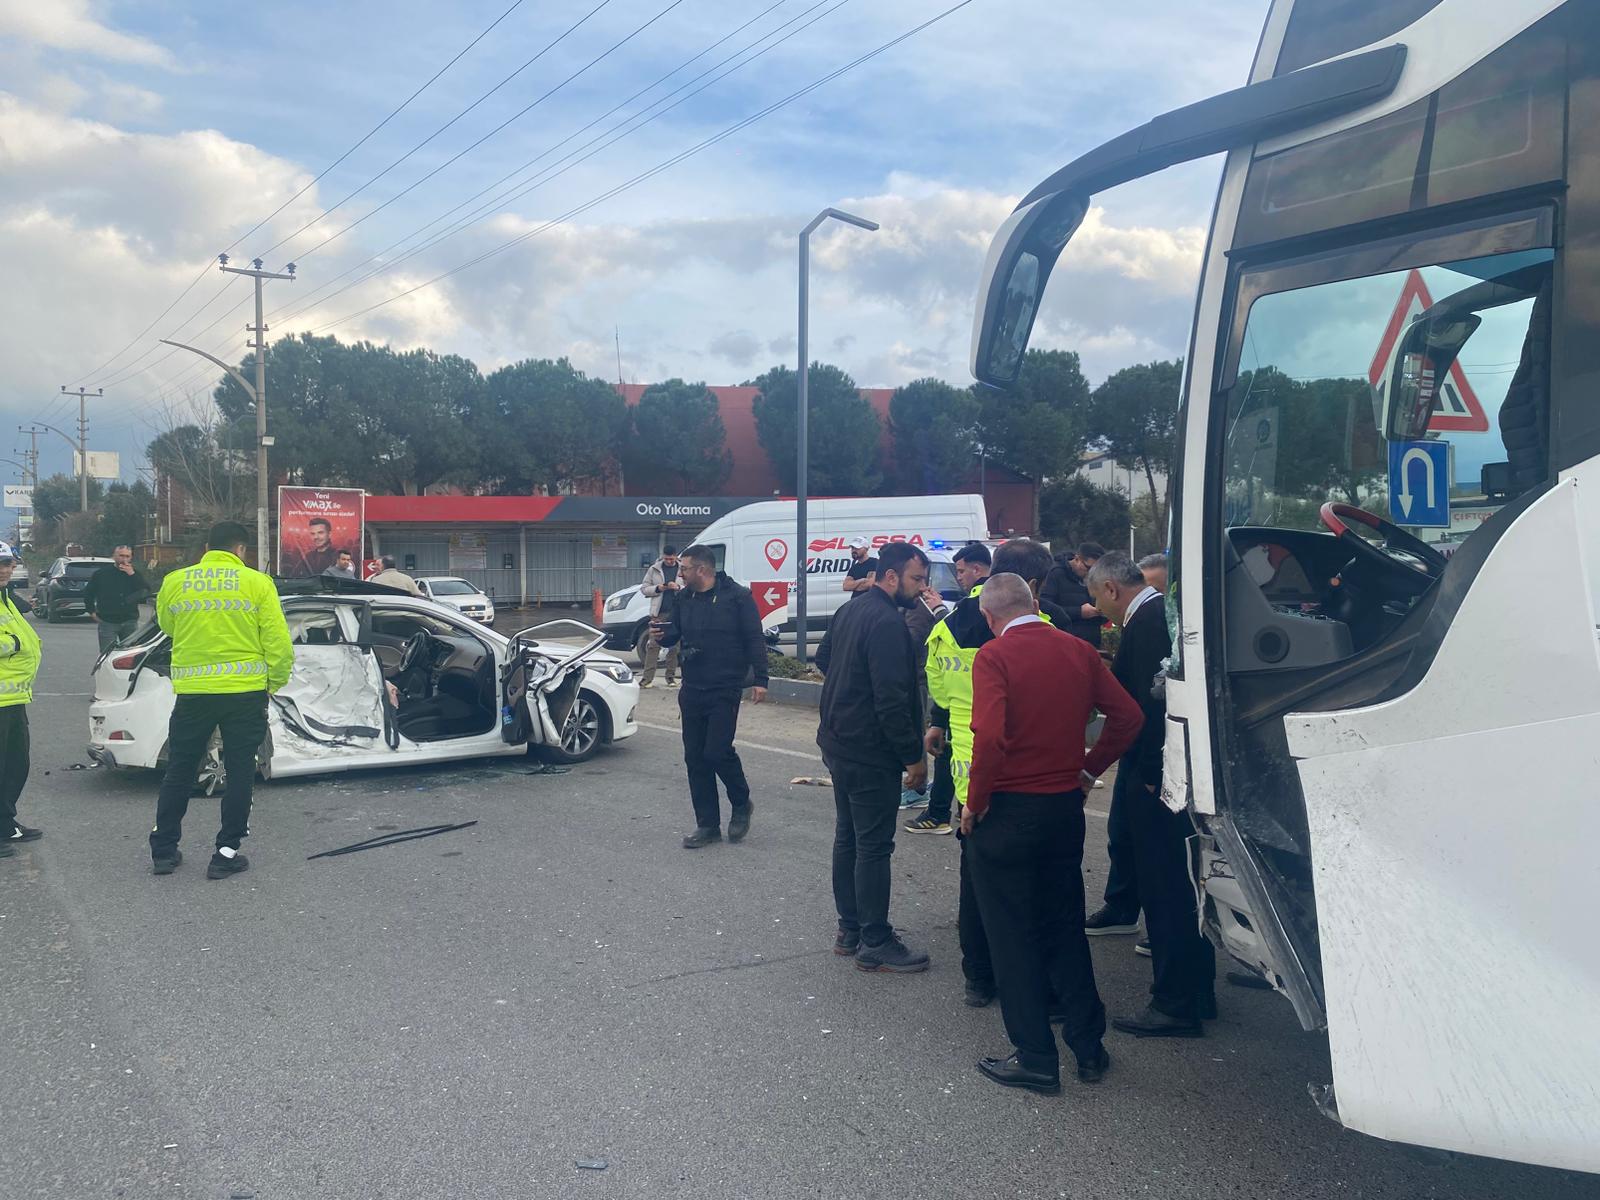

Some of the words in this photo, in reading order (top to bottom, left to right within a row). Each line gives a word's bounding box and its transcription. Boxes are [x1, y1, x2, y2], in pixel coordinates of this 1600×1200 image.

[314, 492, 330, 500] Yeni
[636, 503, 662, 515] Oto
[663, 503, 711, 515] Yıkama
[836, 534, 924, 549] LSSA
[806, 558, 852, 573] BRID
